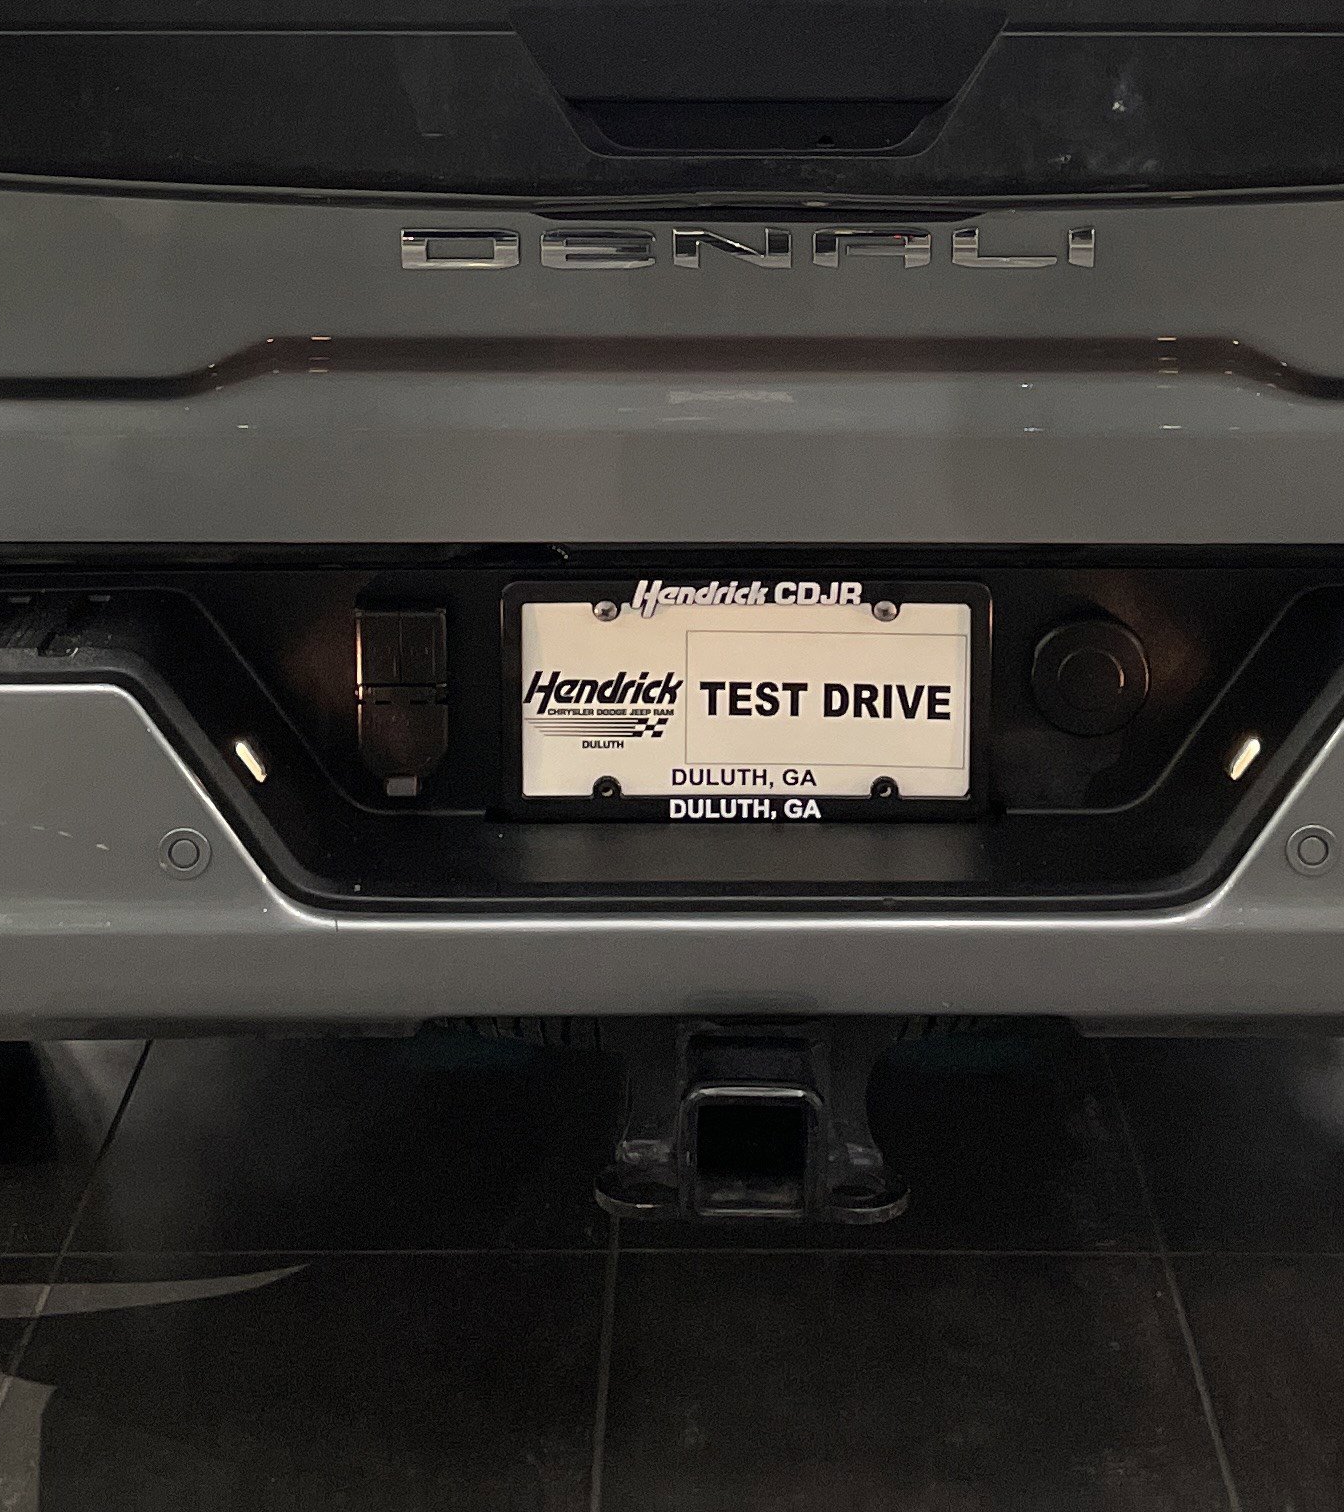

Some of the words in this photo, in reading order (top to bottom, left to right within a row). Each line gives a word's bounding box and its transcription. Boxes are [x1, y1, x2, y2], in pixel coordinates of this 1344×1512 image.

[401, 227, 1096, 269] DENALI
[631, 580, 768, 618] Hendrick
[774, 581, 862, 605] CDJR
[523, 671, 684, 714] Hendrick
[699, 681, 808, 717] TEST
[823, 684, 951, 720] DRIVE
[547, 708, 594, 716] CHRYSLER
[596, 708, 627, 716] DODGE
[629, 708, 651, 716] JEEP
[653, 708, 674, 716] RAM
[582, 740, 624, 749] DULUTH
[671, 768, 774, 789] DULUTH,
[782, 768, 817, 786] GA
[669, 798, 777, 820] DULUTH,
[784, 798, 821, 819] GA
